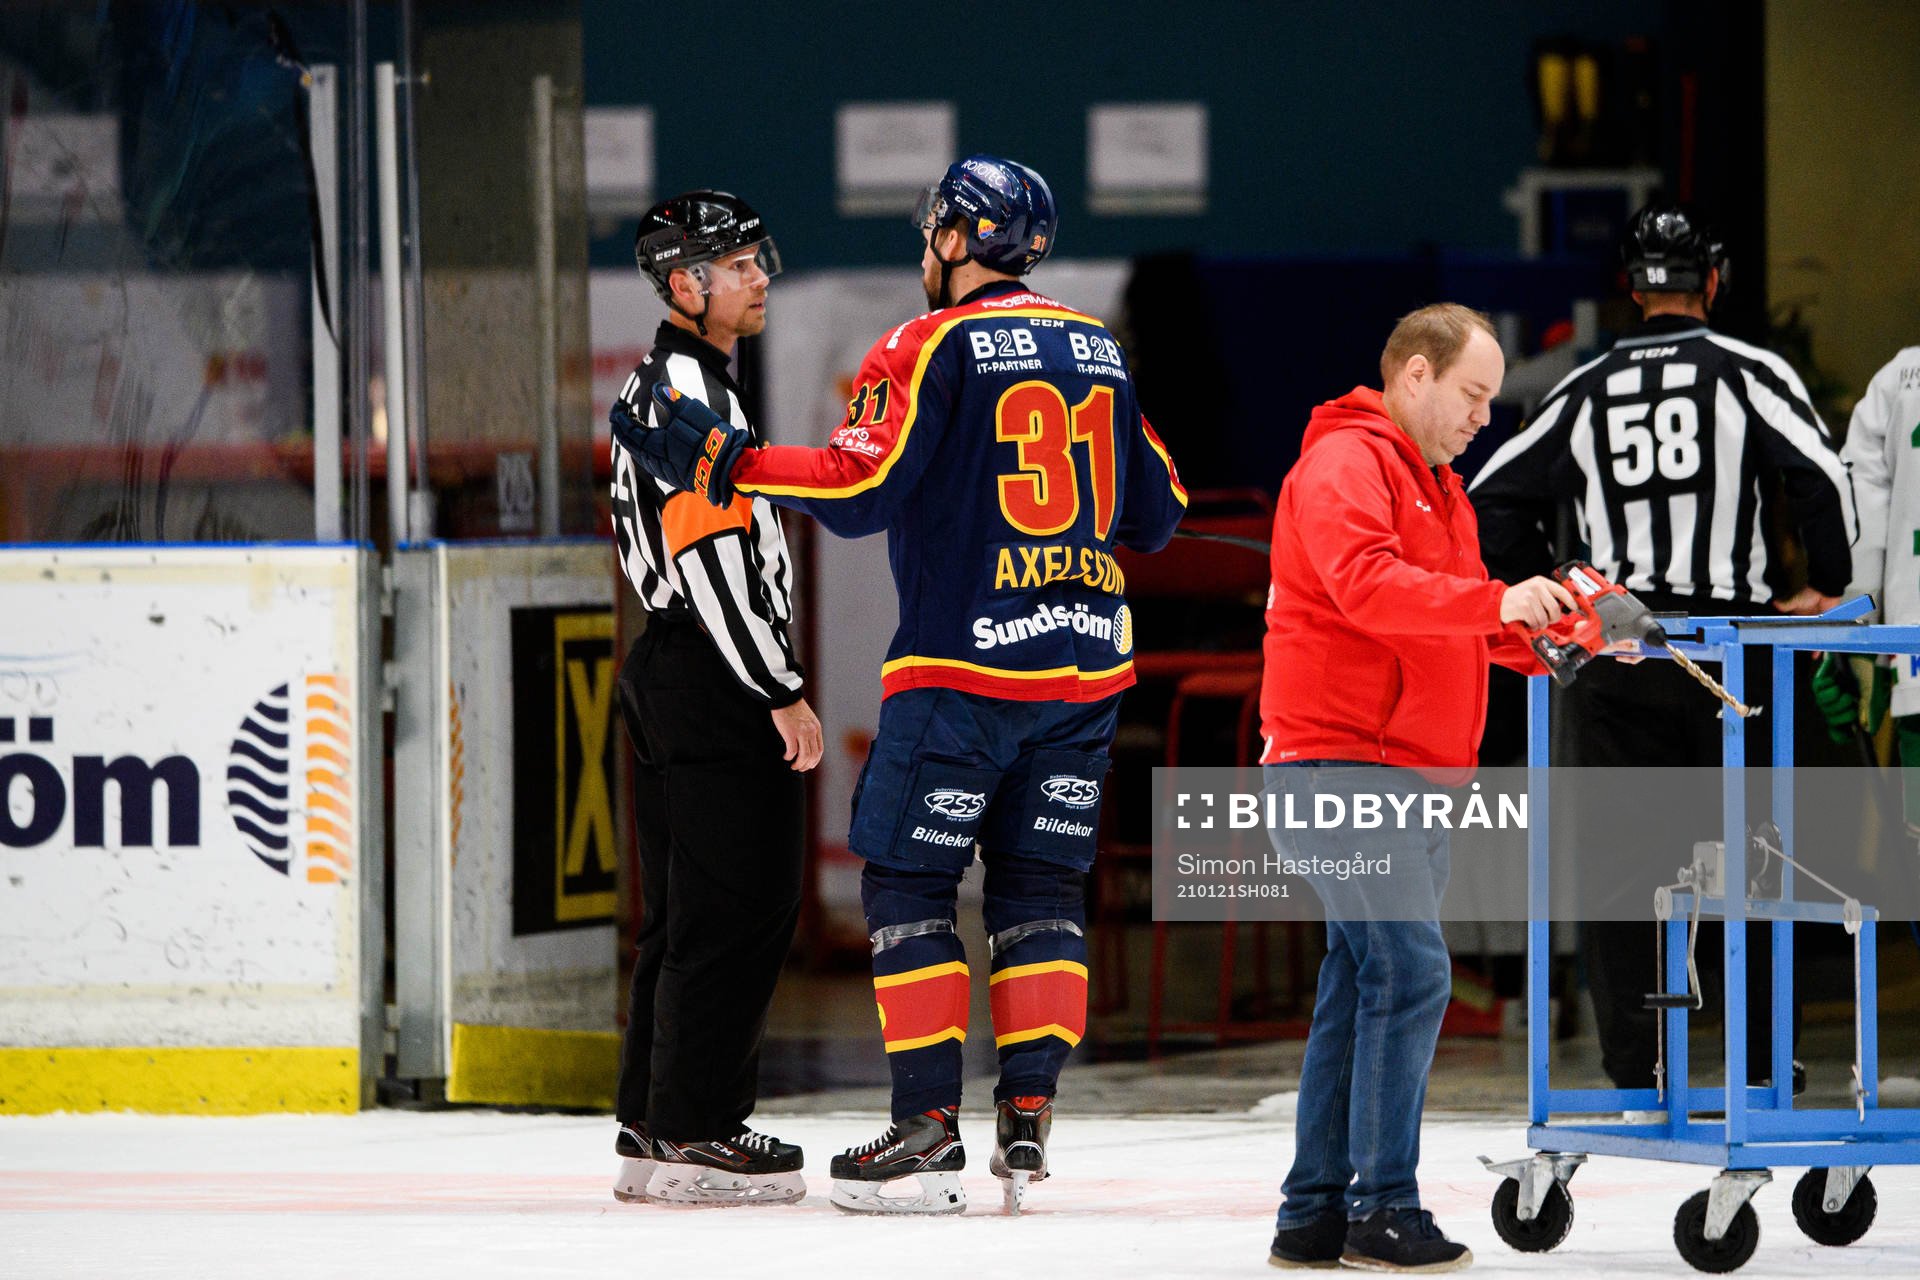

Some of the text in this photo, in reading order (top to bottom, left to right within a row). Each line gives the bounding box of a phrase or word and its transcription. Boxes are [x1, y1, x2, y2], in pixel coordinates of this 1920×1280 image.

[960, 159, 1007, 187] ROTOTEC
[954, 194, 978, 212] CCM
[740, 217, 760, 232] CCM
[1030, 234, 1047, 252] 31
[655, 247, 681, 261] CCM
[1646, 266, 1667, 284] 58
[1029, 318, 1065, 329] CCM
[969, 328, 1038, 360] B2B
[1069, 331, 1121, 367] B2B
[1629, 345, 1679, 360] CCM
[976, 359, 1043, 375] IT-PARTNER
[1076, 363, 1128, 382] IT-PARTNER
[847, 378, 890, 429] 31
[1606, 396, 1700, 487] 58
[995, 380, 1115, 541] 31
[994, 545, 1126, 595] AXELSSON
[972, 603, 1113, 650] Sundsröm
[1048, 780, 1098, 802] RSS
[929, 793, 985, 814] RSS
[911, 826, 974, 848] Bildekor
[1033, 816, 1094, 837] Bildekor
[709, 1140, 734, 1157] CM
[874, 1140, 905, 1163] CCM
